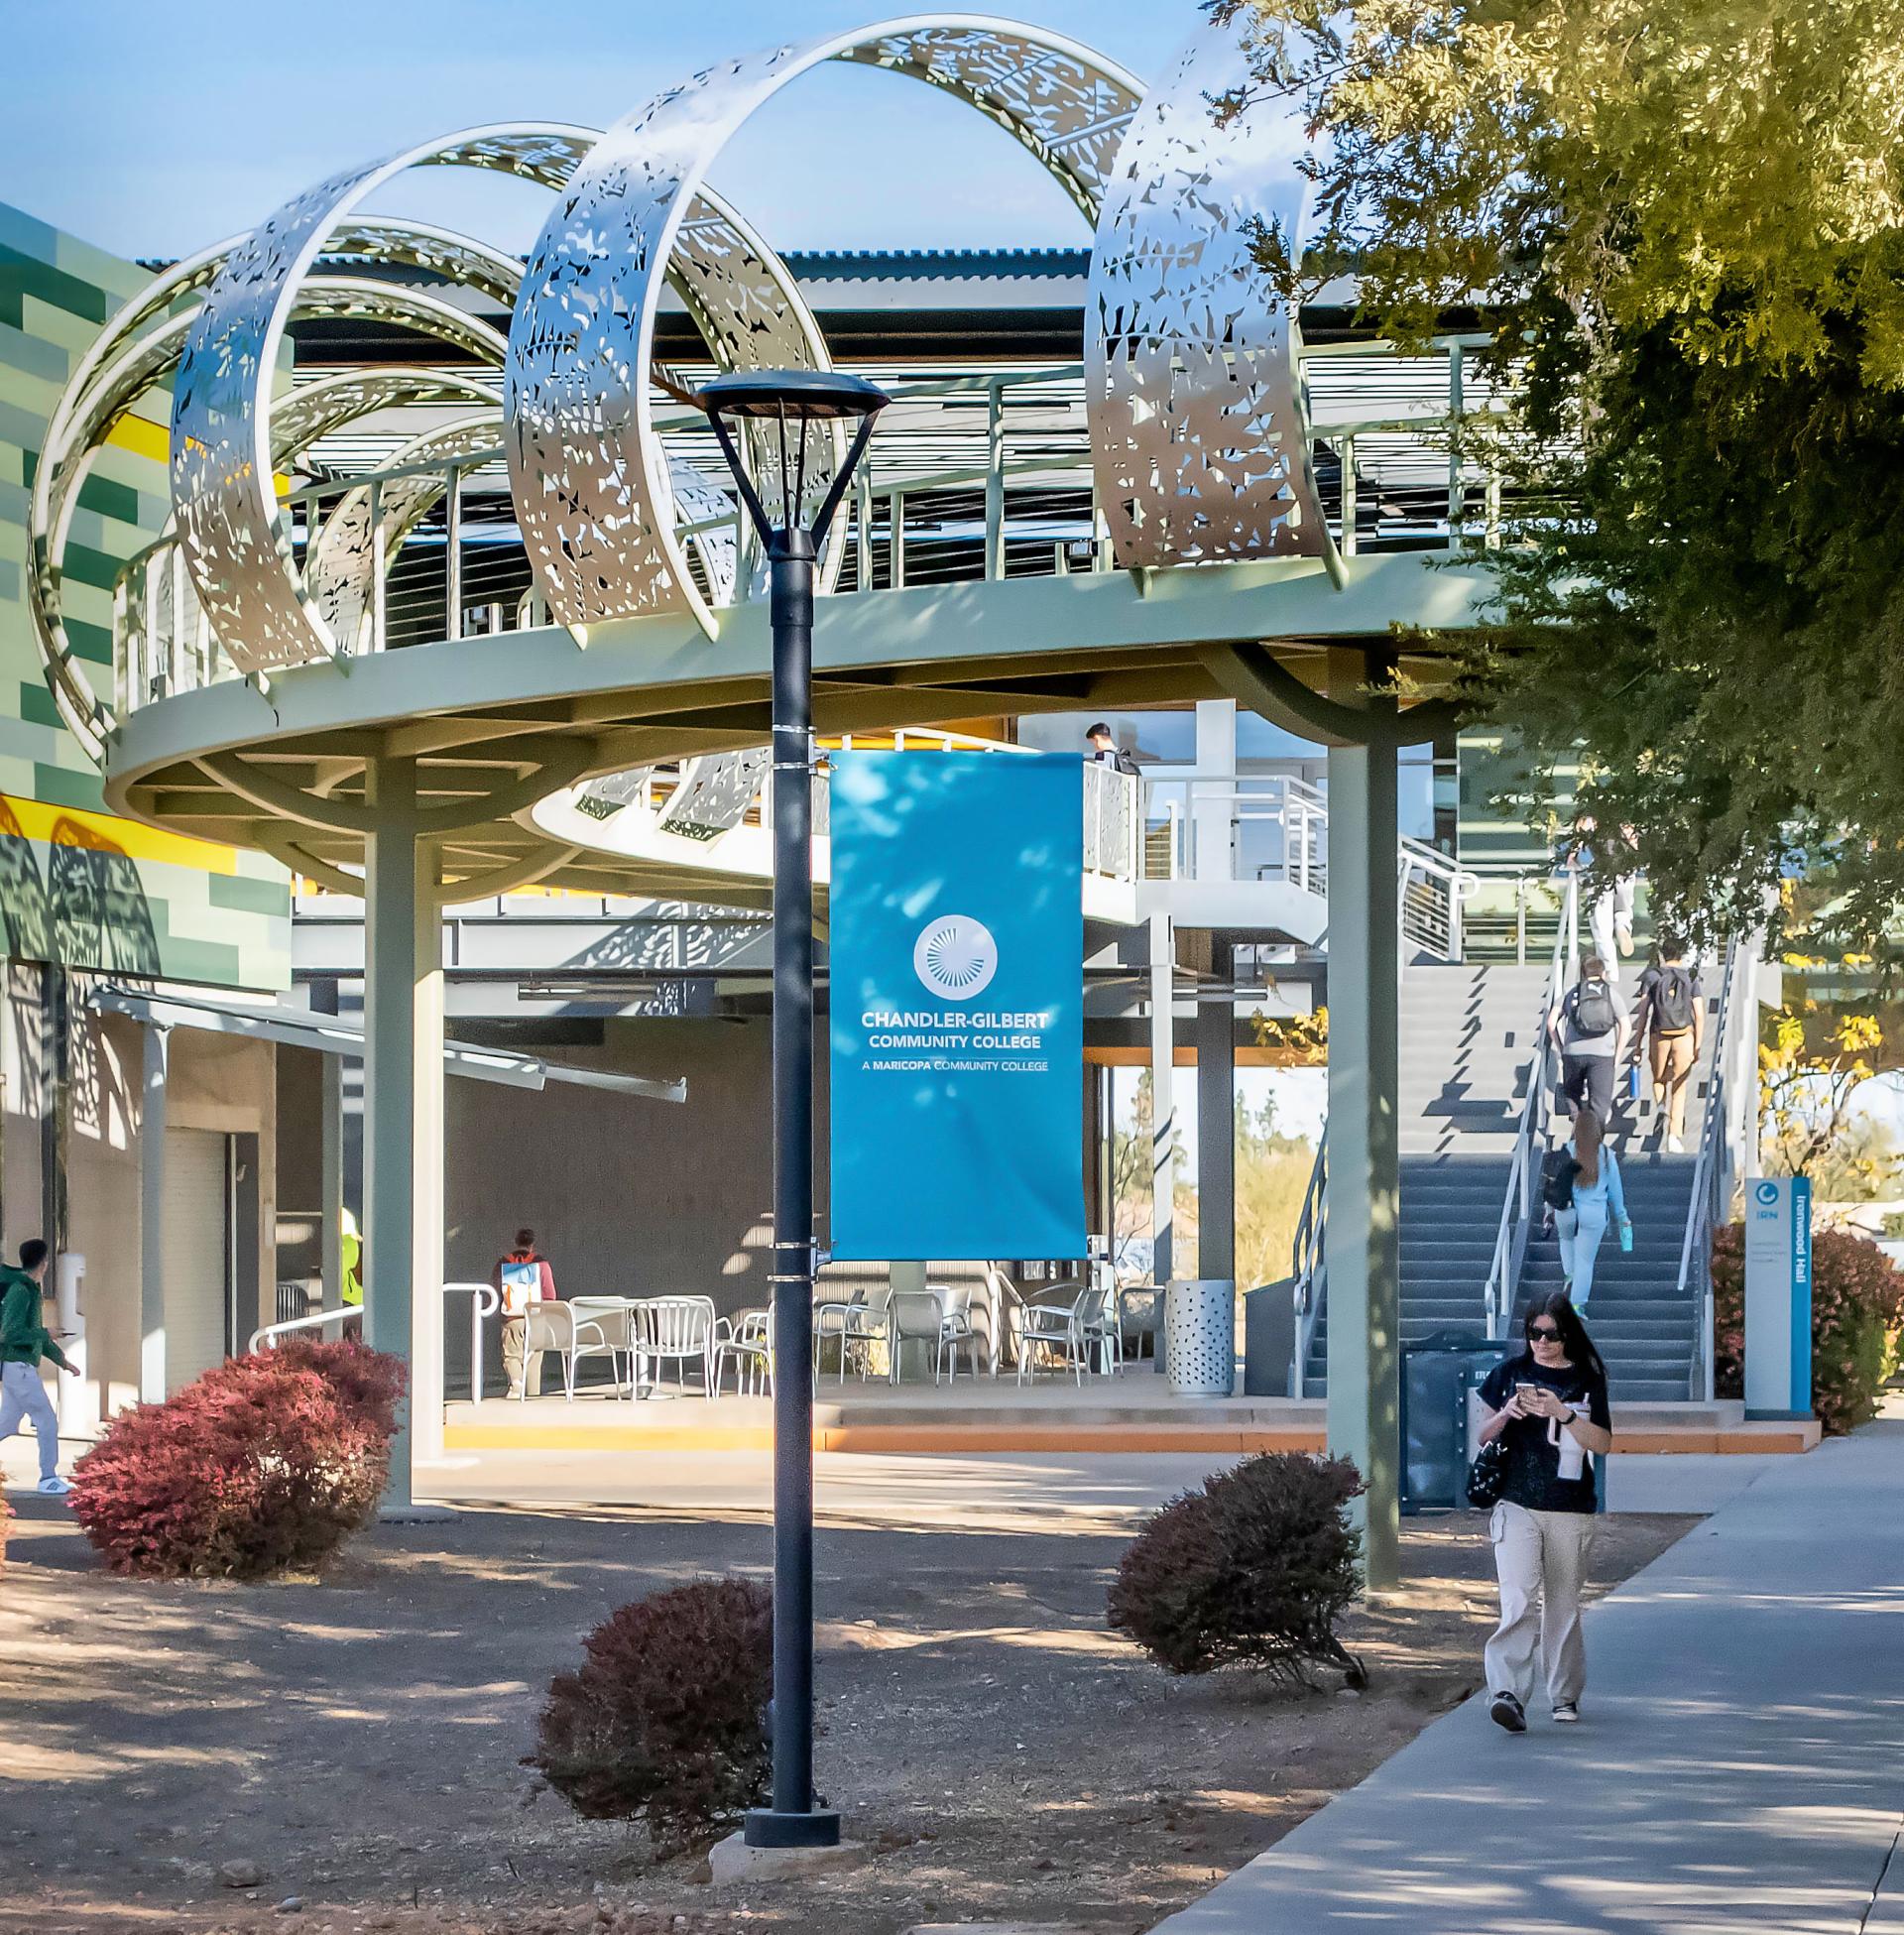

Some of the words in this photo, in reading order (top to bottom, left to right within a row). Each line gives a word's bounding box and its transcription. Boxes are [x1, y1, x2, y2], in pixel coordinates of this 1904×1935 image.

[861, 1012, 1049, 1028] CHANDLER-GILBERT
[869, 1034, 969, 1048] COMMUNITY
[973, 1035, 1041, 1049] COLLEGE
[862, 1060, 871, 1070] A
[873, 1060, 931, 1071] MARICOPA
[933, 1060, 999, 1071] COMMUNITY
[1001, 1061, 1048, 1072] COLLEGE
[1756, 1211, 1778, 1220] IRN
[1796, 1258, 1807, 1283] Hall
